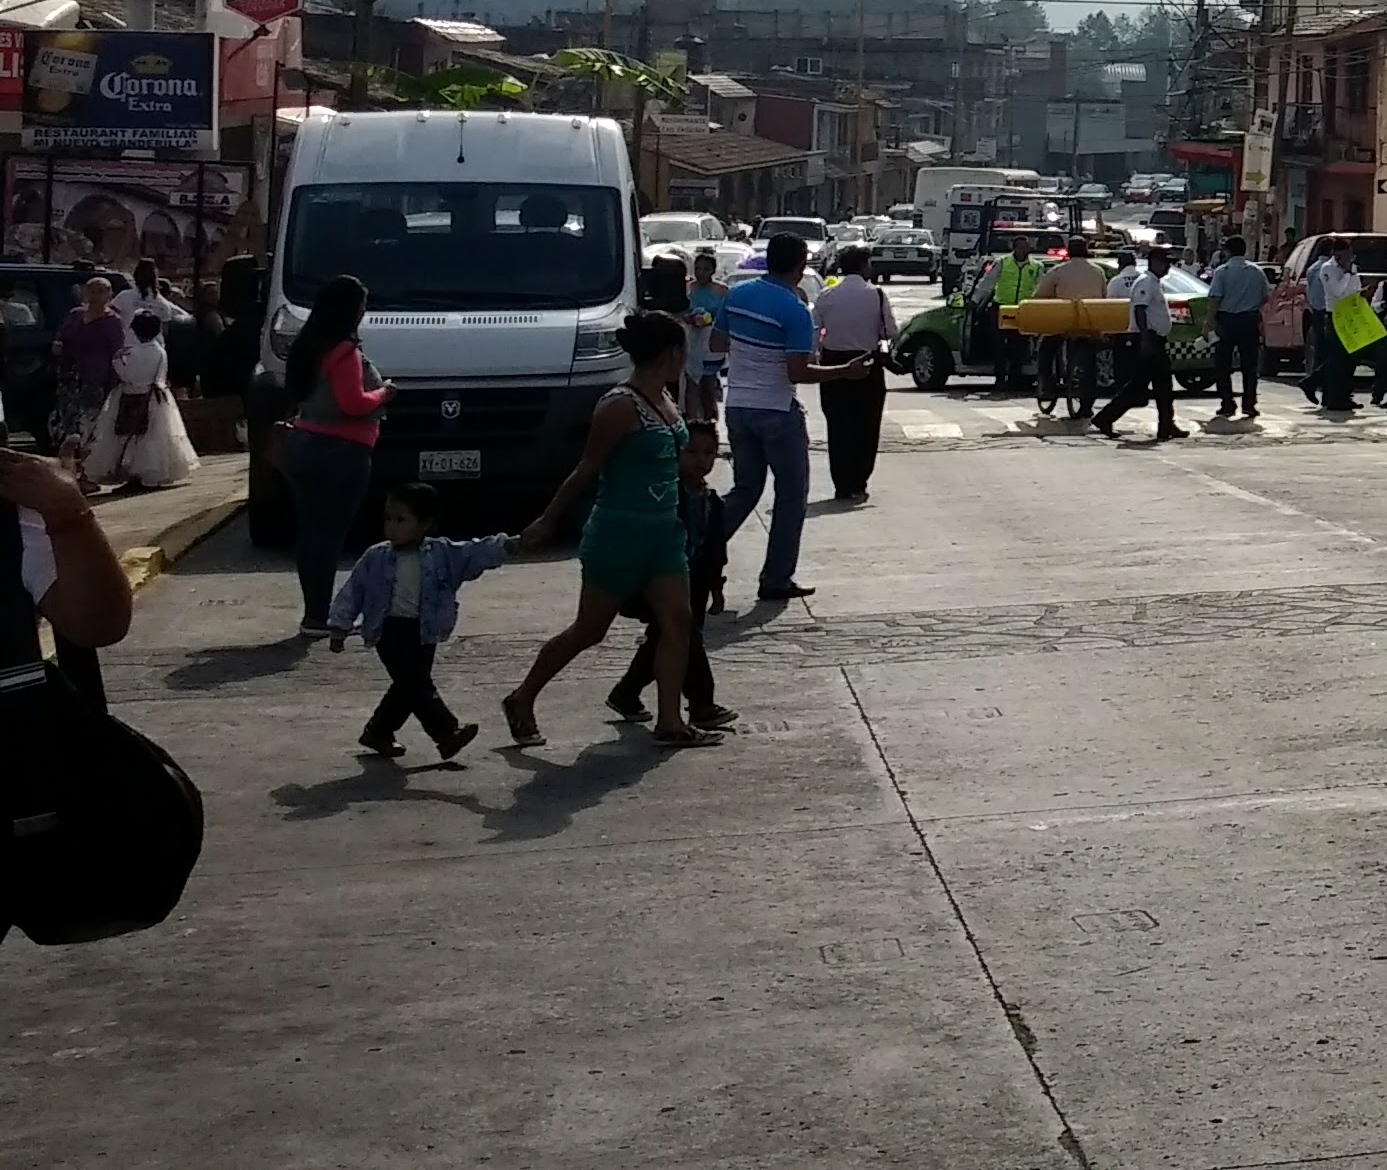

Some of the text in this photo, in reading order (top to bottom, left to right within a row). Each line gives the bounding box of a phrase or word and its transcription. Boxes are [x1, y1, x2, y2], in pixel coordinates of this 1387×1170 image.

[41, 50, 92, 70] Corona
[99, 71, 199, 105] Corona
[128, 98, 173, 112] Extra
[34, 129, 198, 139] RESTAURANT FAMILIAR
[52, 139, 99, 148] NUEVO
